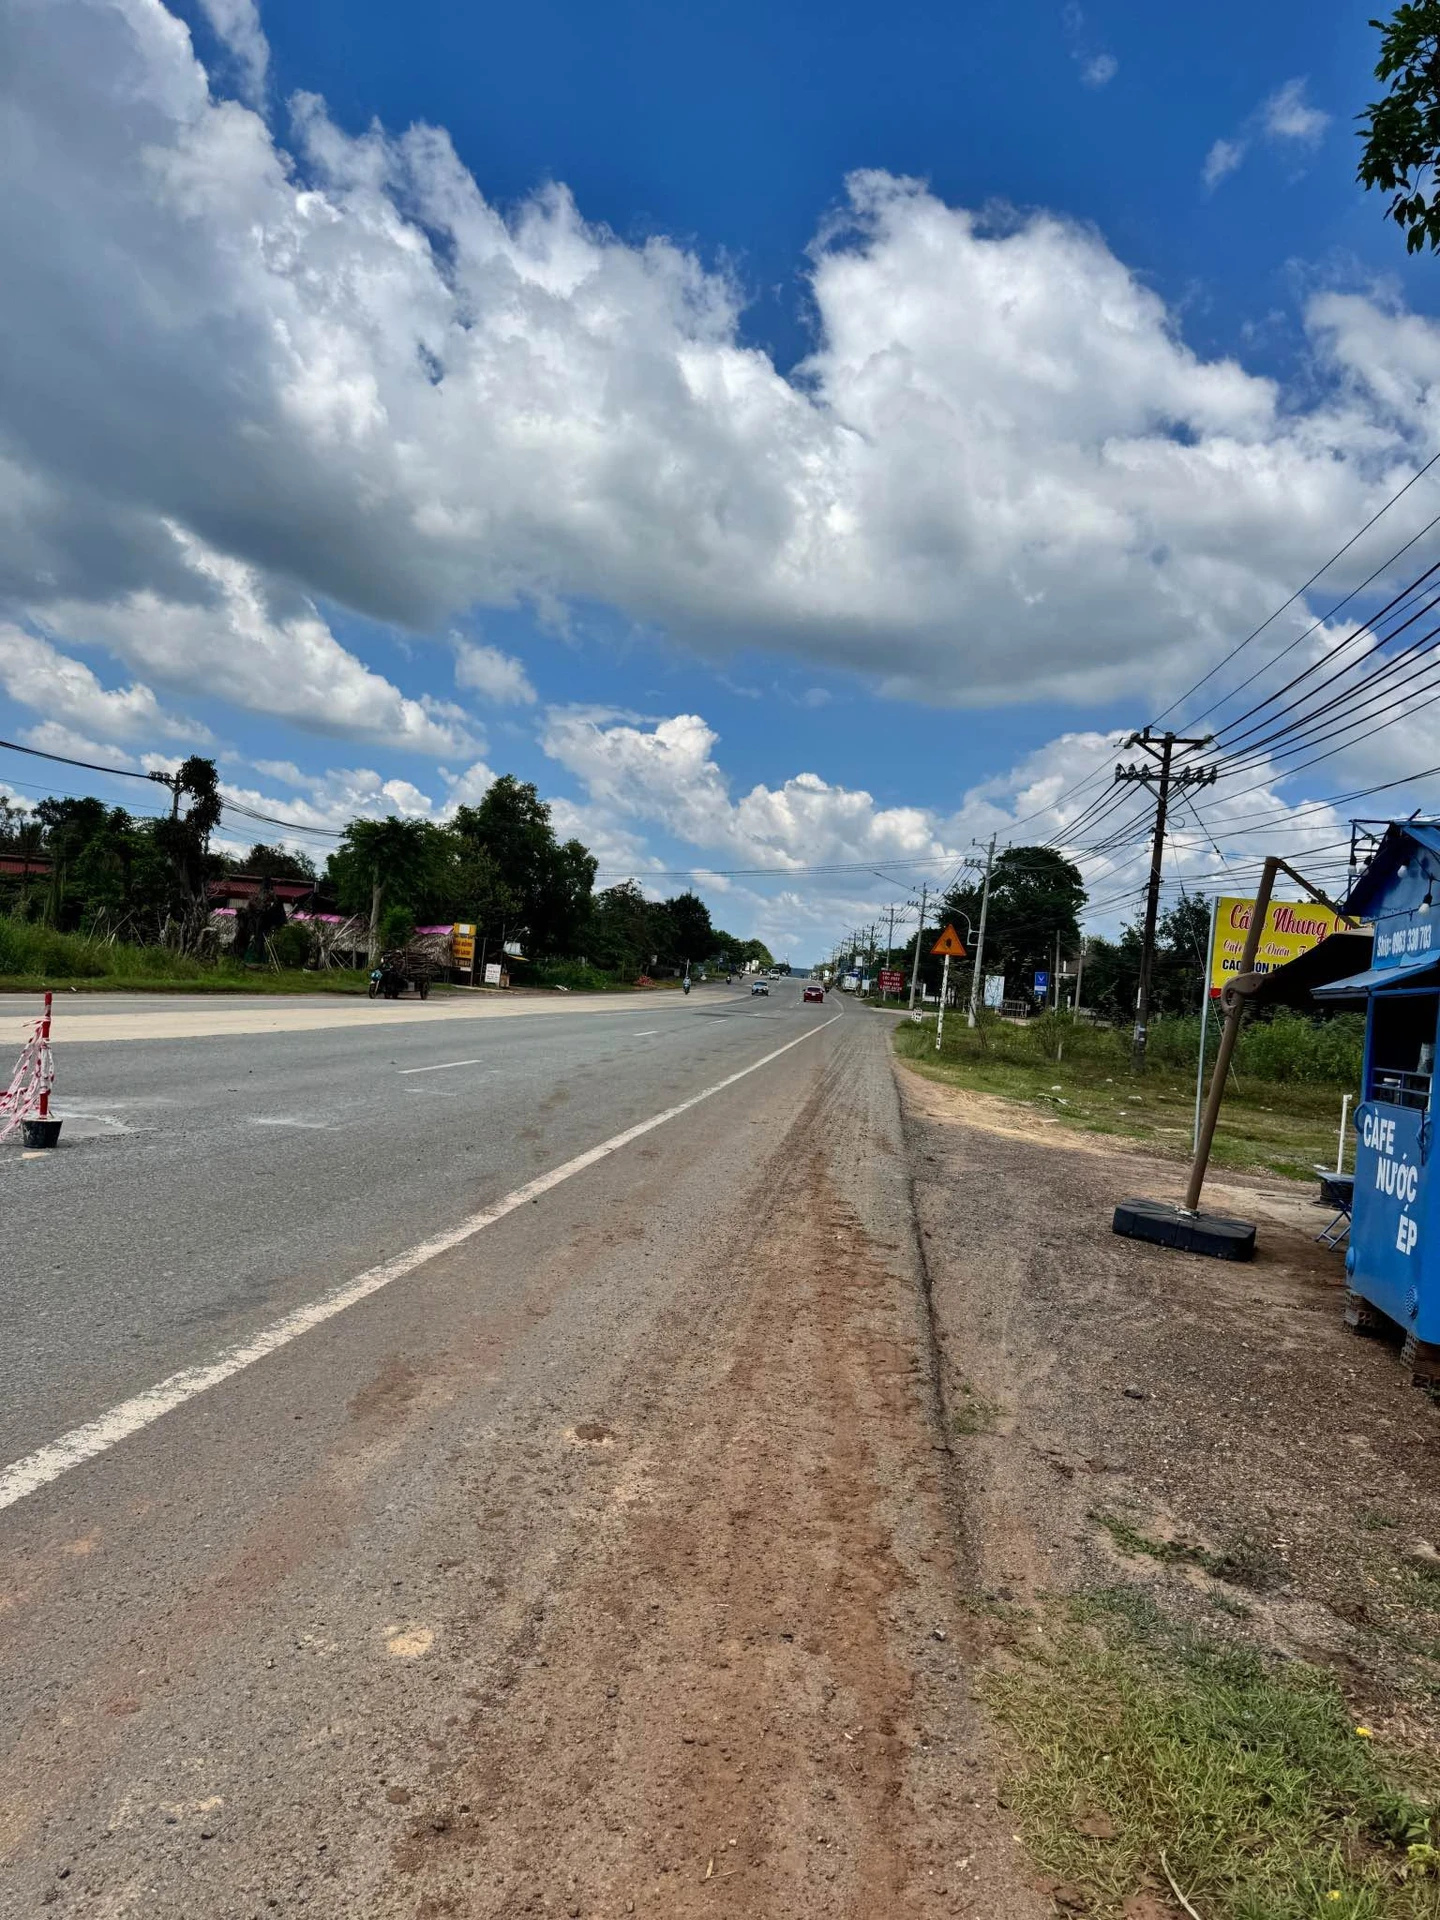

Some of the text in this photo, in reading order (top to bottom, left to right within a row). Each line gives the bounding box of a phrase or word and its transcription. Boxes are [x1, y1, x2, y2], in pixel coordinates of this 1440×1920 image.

[1230, 903, 1266, 930] Cẩ
[1273, 906, 1327, 943] Nhung
[1363, 1107, 1395, 1155] CÀFE
[1375, 1153, 1418, 1203] NƯỚC
[1396, 1204, 1418, 1255] ÉP
